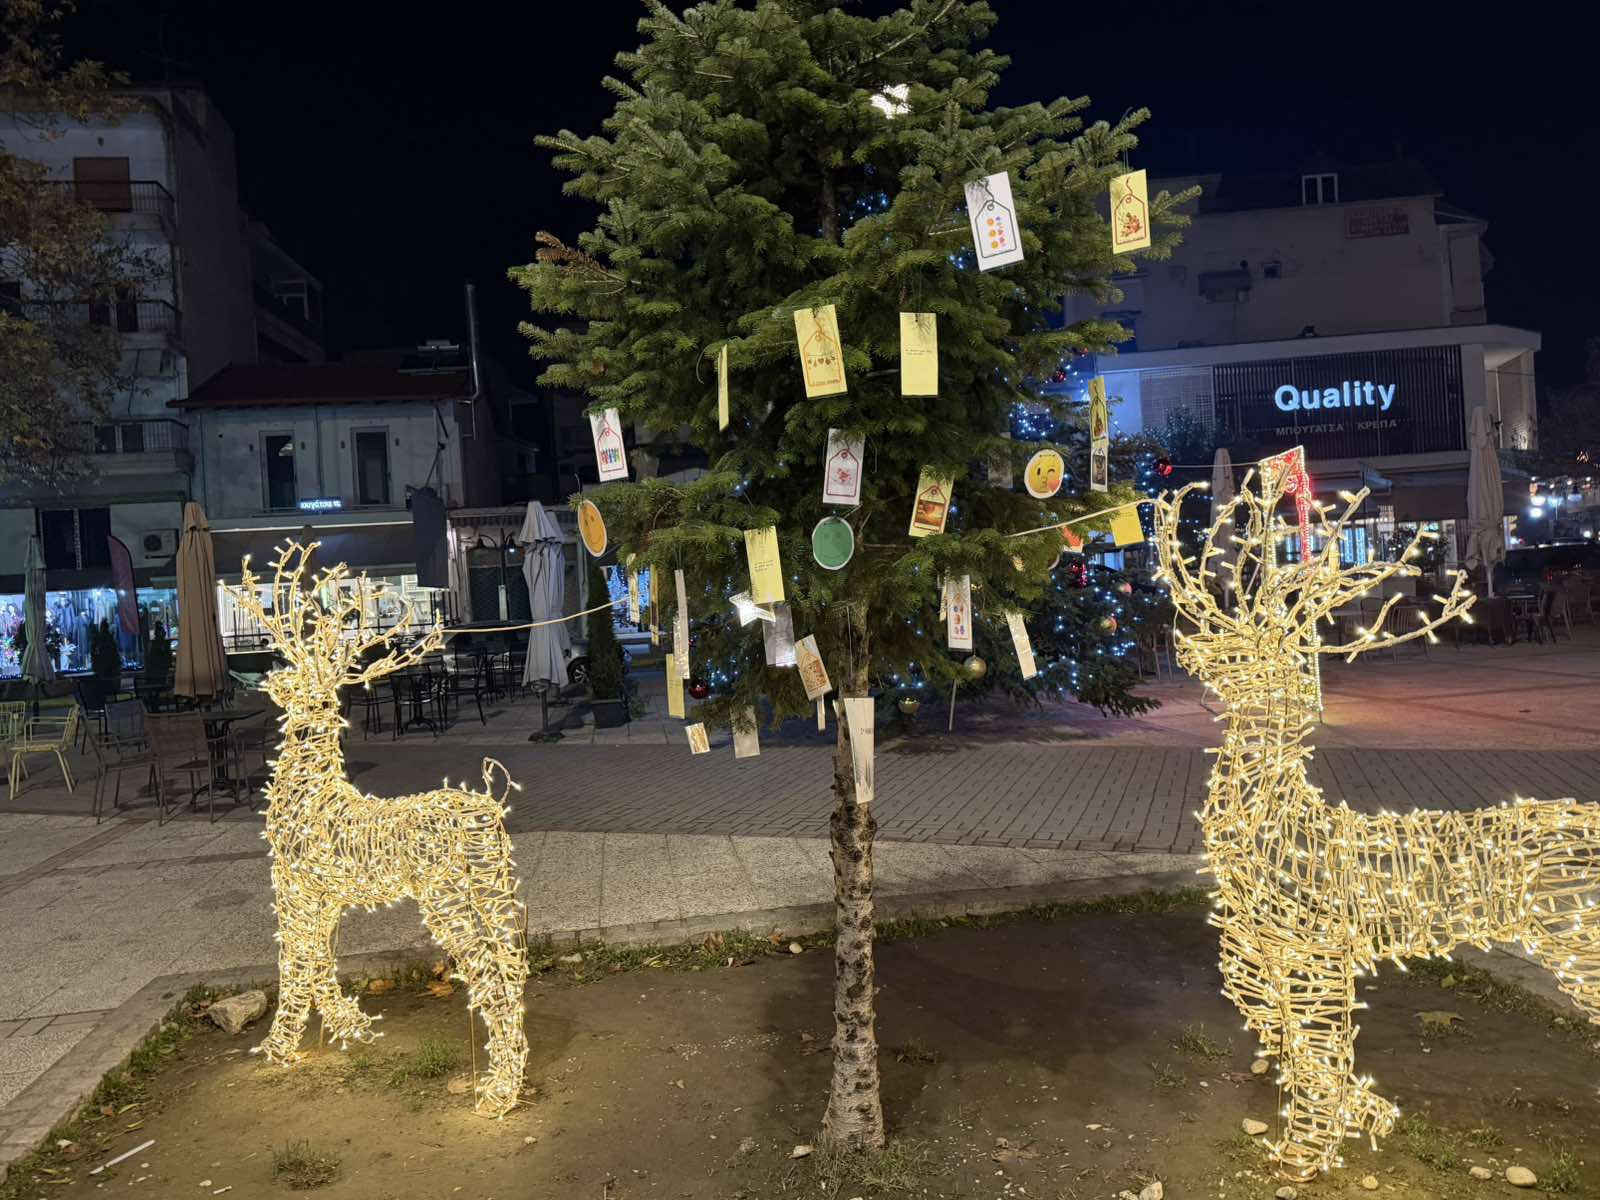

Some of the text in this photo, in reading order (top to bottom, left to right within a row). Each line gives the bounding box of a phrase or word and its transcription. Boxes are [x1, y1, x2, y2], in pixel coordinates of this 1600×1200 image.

[1274, 380, 1397, 412] Quality
[1275, 418, 1398, 436] ΜΠΟΥΓΑΤΣΑ ΚΡΕΠΑ
